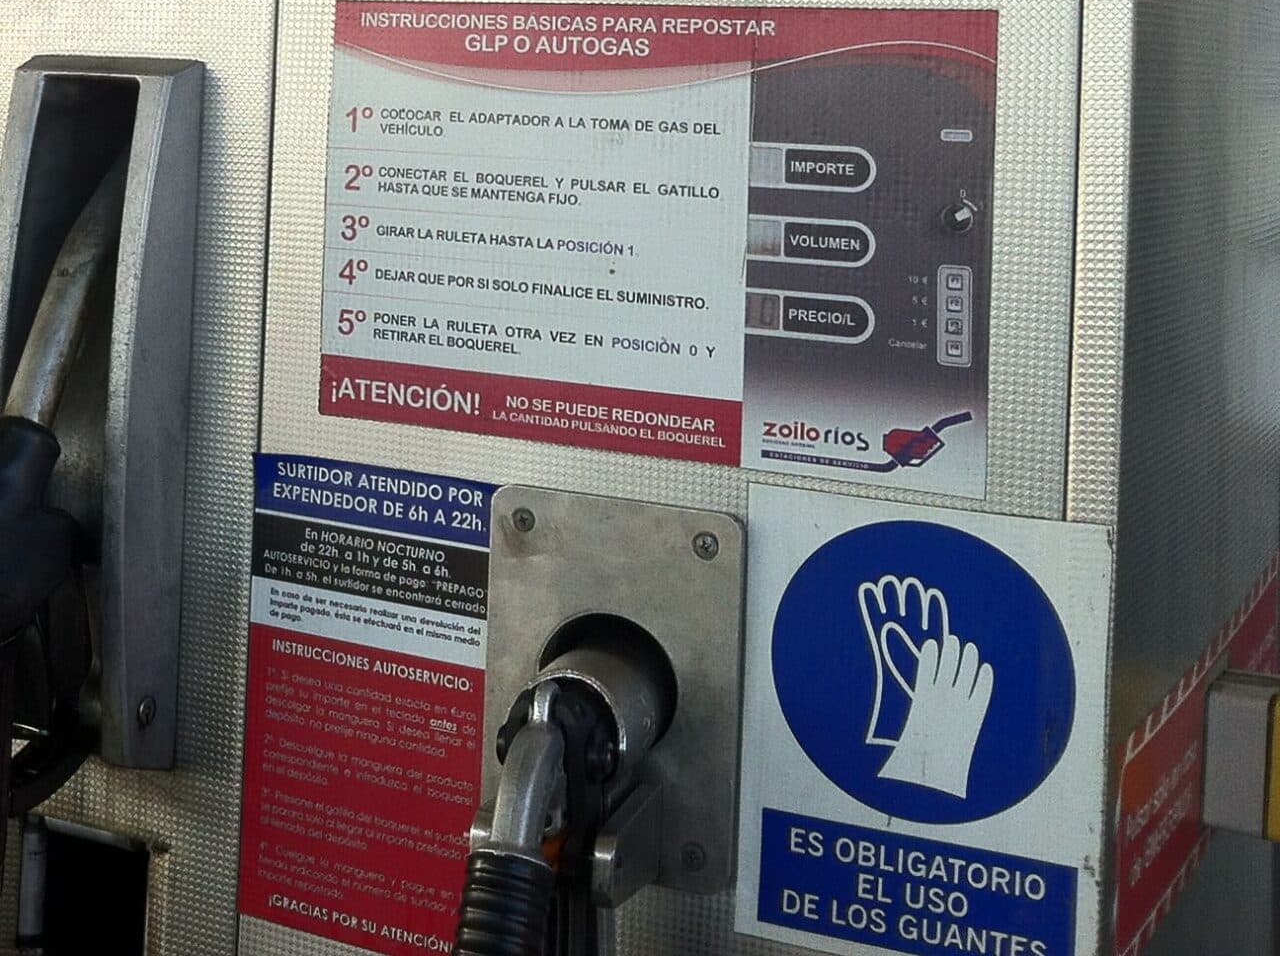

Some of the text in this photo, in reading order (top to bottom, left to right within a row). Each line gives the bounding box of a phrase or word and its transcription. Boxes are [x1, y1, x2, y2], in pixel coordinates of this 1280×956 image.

[361, 12, 508, 30] INSTRUCCIONES
[602, 16, 657, 33] PARA
[662, 18, 776, 37] REPOSTAR
[465, 34, 650, 56] GLP O AUTOGAS
[346, 107, 721, 135] 1º COLOCAR EL ADAPTADOR A LA TOMA DE GAS DEL
[344, 164, 720, 199] 2º CONECTAR EL BOQUEREL Y PULSAR EL GATILLO
[790, 160, 855, 176] IMPORTE
[378, 182, 581, 206] HASTA QUE SE MANTENGA FIJO.
[341, 214, 624, 256] 3º GIRAR LA RULETA HASTA LA POSICIÓN
[789, 234, 860, 251] VOLUMEN
[338, 258, 709, 310] 4º DEJAR QUE POR SI SOLO FINALICE EL SUMINISTRO.
[338, 308, 367, 335] 5º
[373, 312, 416, 327] PONER
[423, 317, 440, 330] LA
[446, 320, 497, 336] RULETA
[505, 325, 542, 341] OTRA
[549, 330, 576, 344] VEZ
[584, 334, 603, 347] EN
[706, 346, 716, 358] Y
[788, 308, 856, 326] PRECIO/L
[373, 328, 426, 345] RETIRAR
[429, 334, 444, 346] EL
[331, 377, 481, 416] ¡ATENCIÓN!
[506, 395, 715, 432] NO SE PUEDE REDONDEAR
[492, 410, 727, 448] LA CANTIDAD PULSANDO EL BOQUEREL
[763, 421, 820, 442] zoilo
[823, 426, 870, 452] ríos
[277, 461, 483, 508] SURTIDOR ATENDIDO POR
[272, 482, 487, 532] EXPENDEDOR DE 6h A 22h.
[305, 528, 319, 541] En
[321, 530, 375, 551] HORARIO
[263, 548, 331, 570] AUTOSERVICIO
[332, 563, 338, 574] y
[340, 563, 350, 575] la
[352, 565, 381, 581] forma
[383, 570, 397, 583] de
[300, 541, 316, 554] de
[344, 552, 353, 561] a
[372, 556, 380, 568] y
[383, 556, 398, 569] de
[422, 565, 431, 575] a
[264, 562, 278, 575] De
[322, 574, 332, 586] el
[334, 575, 370, 593] surtidor
[371, 584, 383, 596] se
[386, 586, 442, 606] encontrará
[272, 639, 474, 693] INSTRUCCIONES AUTOSERVICIO:
[429, 717, 458, 732] antes
[790, 827, 1046, 900] ES OBLIGATORIO
[782, 889, 820, 920] DE
[831, 899, 886, 933] LOS
[857, 873, 969, 918] EL USO
[268, 894, 328, 922] ¡GRACIAS
[332, 908, 359, 929] POR
[361, 916, 377, 934] SU
